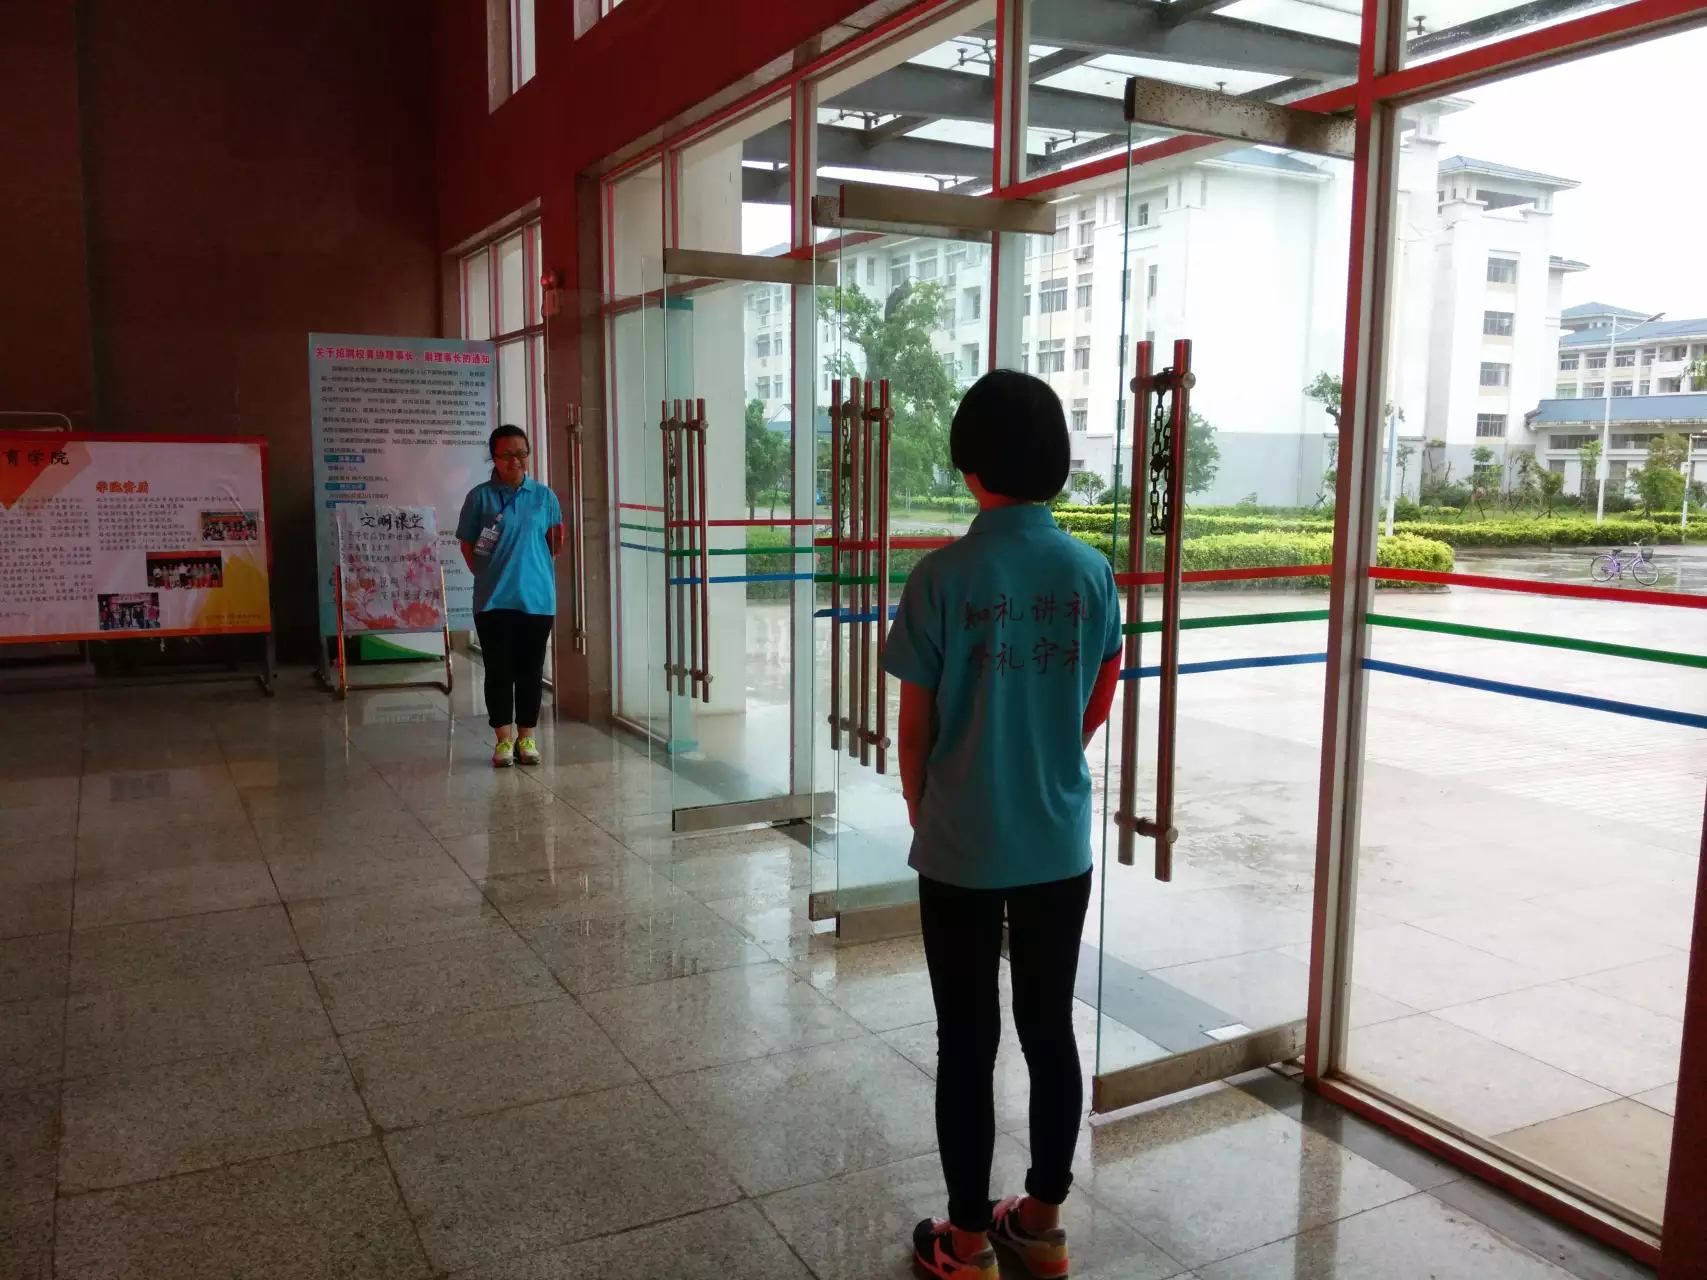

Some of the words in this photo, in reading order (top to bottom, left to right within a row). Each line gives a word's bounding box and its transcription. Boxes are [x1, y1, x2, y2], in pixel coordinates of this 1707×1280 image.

[2, 449, 70, 467] 育学院
[360, 512, 425, 531] 文明课堂
[964, 591, 1092, 630] 知礼讲礼
